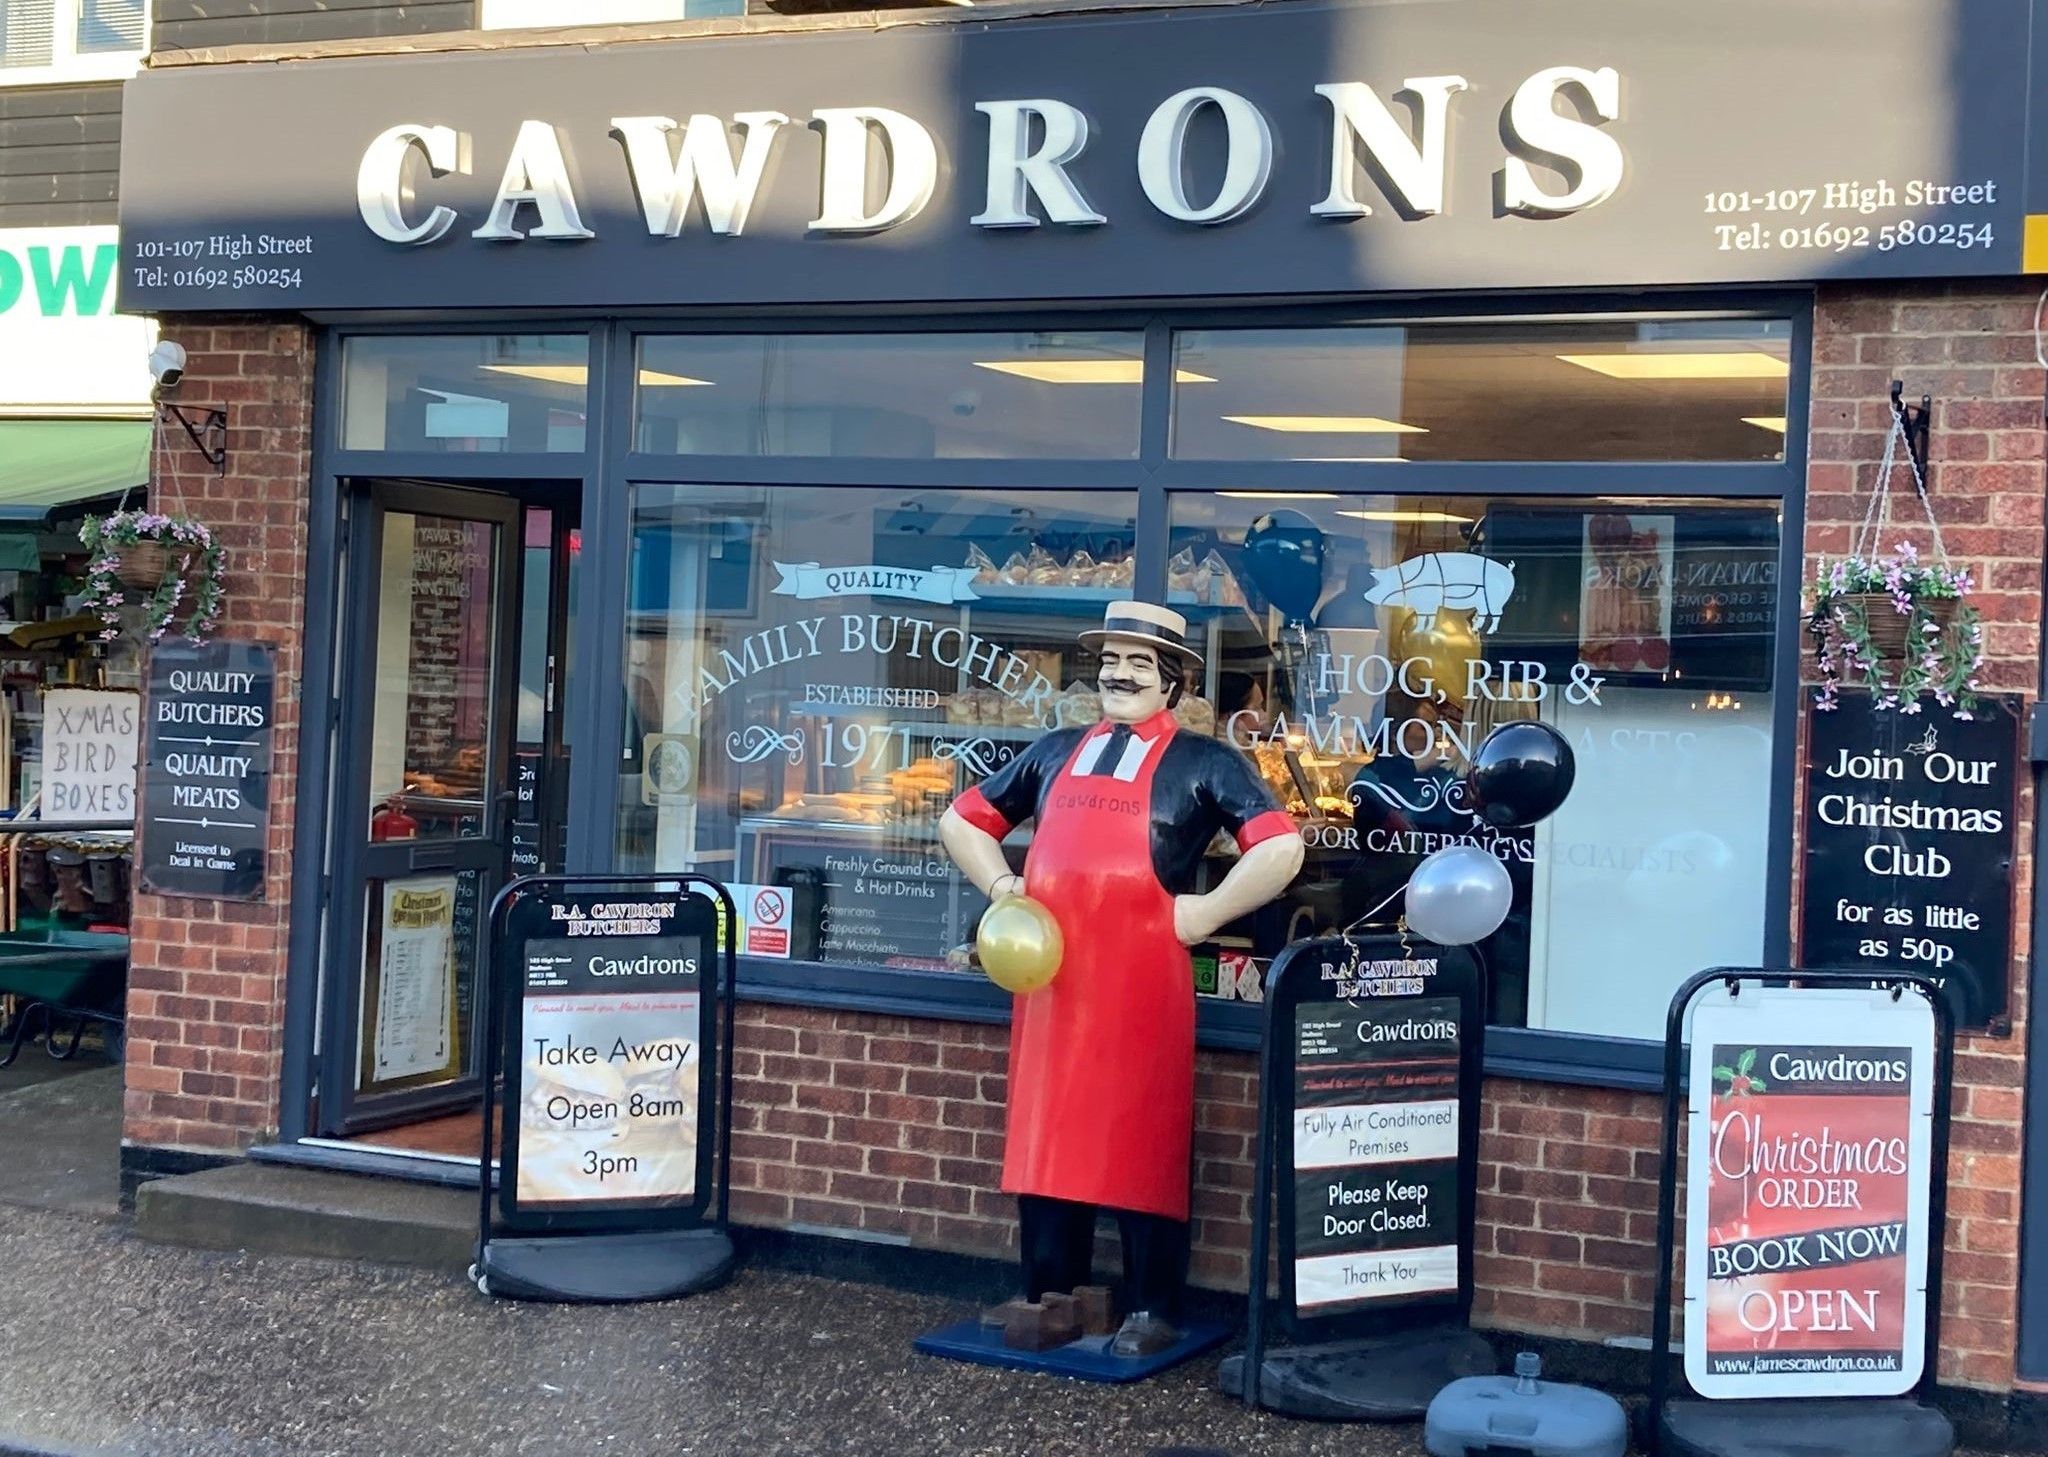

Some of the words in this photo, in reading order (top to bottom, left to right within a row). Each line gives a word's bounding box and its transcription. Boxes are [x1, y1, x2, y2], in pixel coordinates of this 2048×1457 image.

[357, 66, 1624, 245] CAWDRONS
[1704, 188, 1816, 215] 101-107
[1823, 179, 1896, 214] High
[1905, 180, 1996, 206] Street
[136, 241, 205, 260] 101-107
[209, 234, 253, 260] High
[258, 235, 312, 254] Street
[1715, 222, 1770, 250] Tel:
[1779, 222, 1869, 252] 01692
[1878, 219, 1994, 251] 580254
[135, 267, 168, 287] Tel:
[173, 267, 228, 289] 01692
[233, 265, 302, 289] 580254
[825, 570, 924, 592] QUALITY
[169, 670, 255, 694] QUALITY
[672, 616, 827, 722] FAMILY
[840, 614, 1076, 732] BUTCHERS
[1316, 653, 1446, 705] HOG,
[1462, 658, 1549, 702] RIB
[1564, 662, 1606, 707] &
[804, 683, 939, 710] ESTABLISHED
[56, 703, 133, 735] XMAS
[158, 701, 264, 727] BUTCHERS
[820, 722, 912, 770] 1971
[1226, 710, 1478, 762] GAMMON
[53, 741, 117, 773] BIRD
[165, 753, 252, 778] QUALITY
[1825, 748, 1904, 781] Join
[1924, 752, 1997, 785] Our
[51, 781, 129, 813] BOXES
[173, 785, 241, 811] MEATS
[1817, 794, 2004, 834] Christmas
[169, 854, 192, 868] Deal
[206, 857, 237, 871] Game
[175, 841, 218, 857] Licensed
[220, 844, 231, 858] to
[824, 854, 869, 876] Freshly
[872, 857, 923, 877] Ground
[1863, 844, 1952, 879] Club
[854, 878, 865, 894] &
[869, 879, 893, 895] Hot
[895, 880, 936, 899] Drinks
[591, 902, 677, 919] CAWDRON
[1836, 898, 1874, 924] for
[1883, 909, 1914, 927] as
[1925, 905, 1981, 930] little
[588, 955, 697, 977] Cawdrons
[1858, 938, 1889, 958] as
[1900, 938, 1955, 967] 50p
[1357, 1019, 1457, 1043] Cawdrons
[533, 1034, 598, 1066] Take
[608, 1036, 692, 1070] Away
[1770, 1053, 1907, 1083] Cawdrons
[547, 1096, 618, 1127] Open
[629, 1093, 684, 1118] 8am
[1303, 1112, 1335, 1138] Fully
[1341, 1111, 1364, 1132] Air
[1367, 1104, 1453, 1130] Conditioned
[1349, 1137, 1409, 1157] Premises
[1714, 1110, 1906, 1181] Christmas
[582, 1150, 638, 1182] 3pm
[1328, 1181, 1381, 1207] Please
[1385, 1179, 1429, 1206] Keep
[1758, 1177, 1862, 1210] ORDER
[1323, 1213, 1366, 1238] Door
[1369, 1205, 1431, 1233] Closed.
[1711, 1235, 1811, 1278] BOOK
[1817, 1222, 1904, 1264] NOW
[1342, 1261, 1387, 1286] Thank
[1390, 1261, 1418, 1281] You
[1737, 1288, 1881, 1333] OPEN
[1714, 1354, 1897, 1375] www.jamescawdron.co.uk
